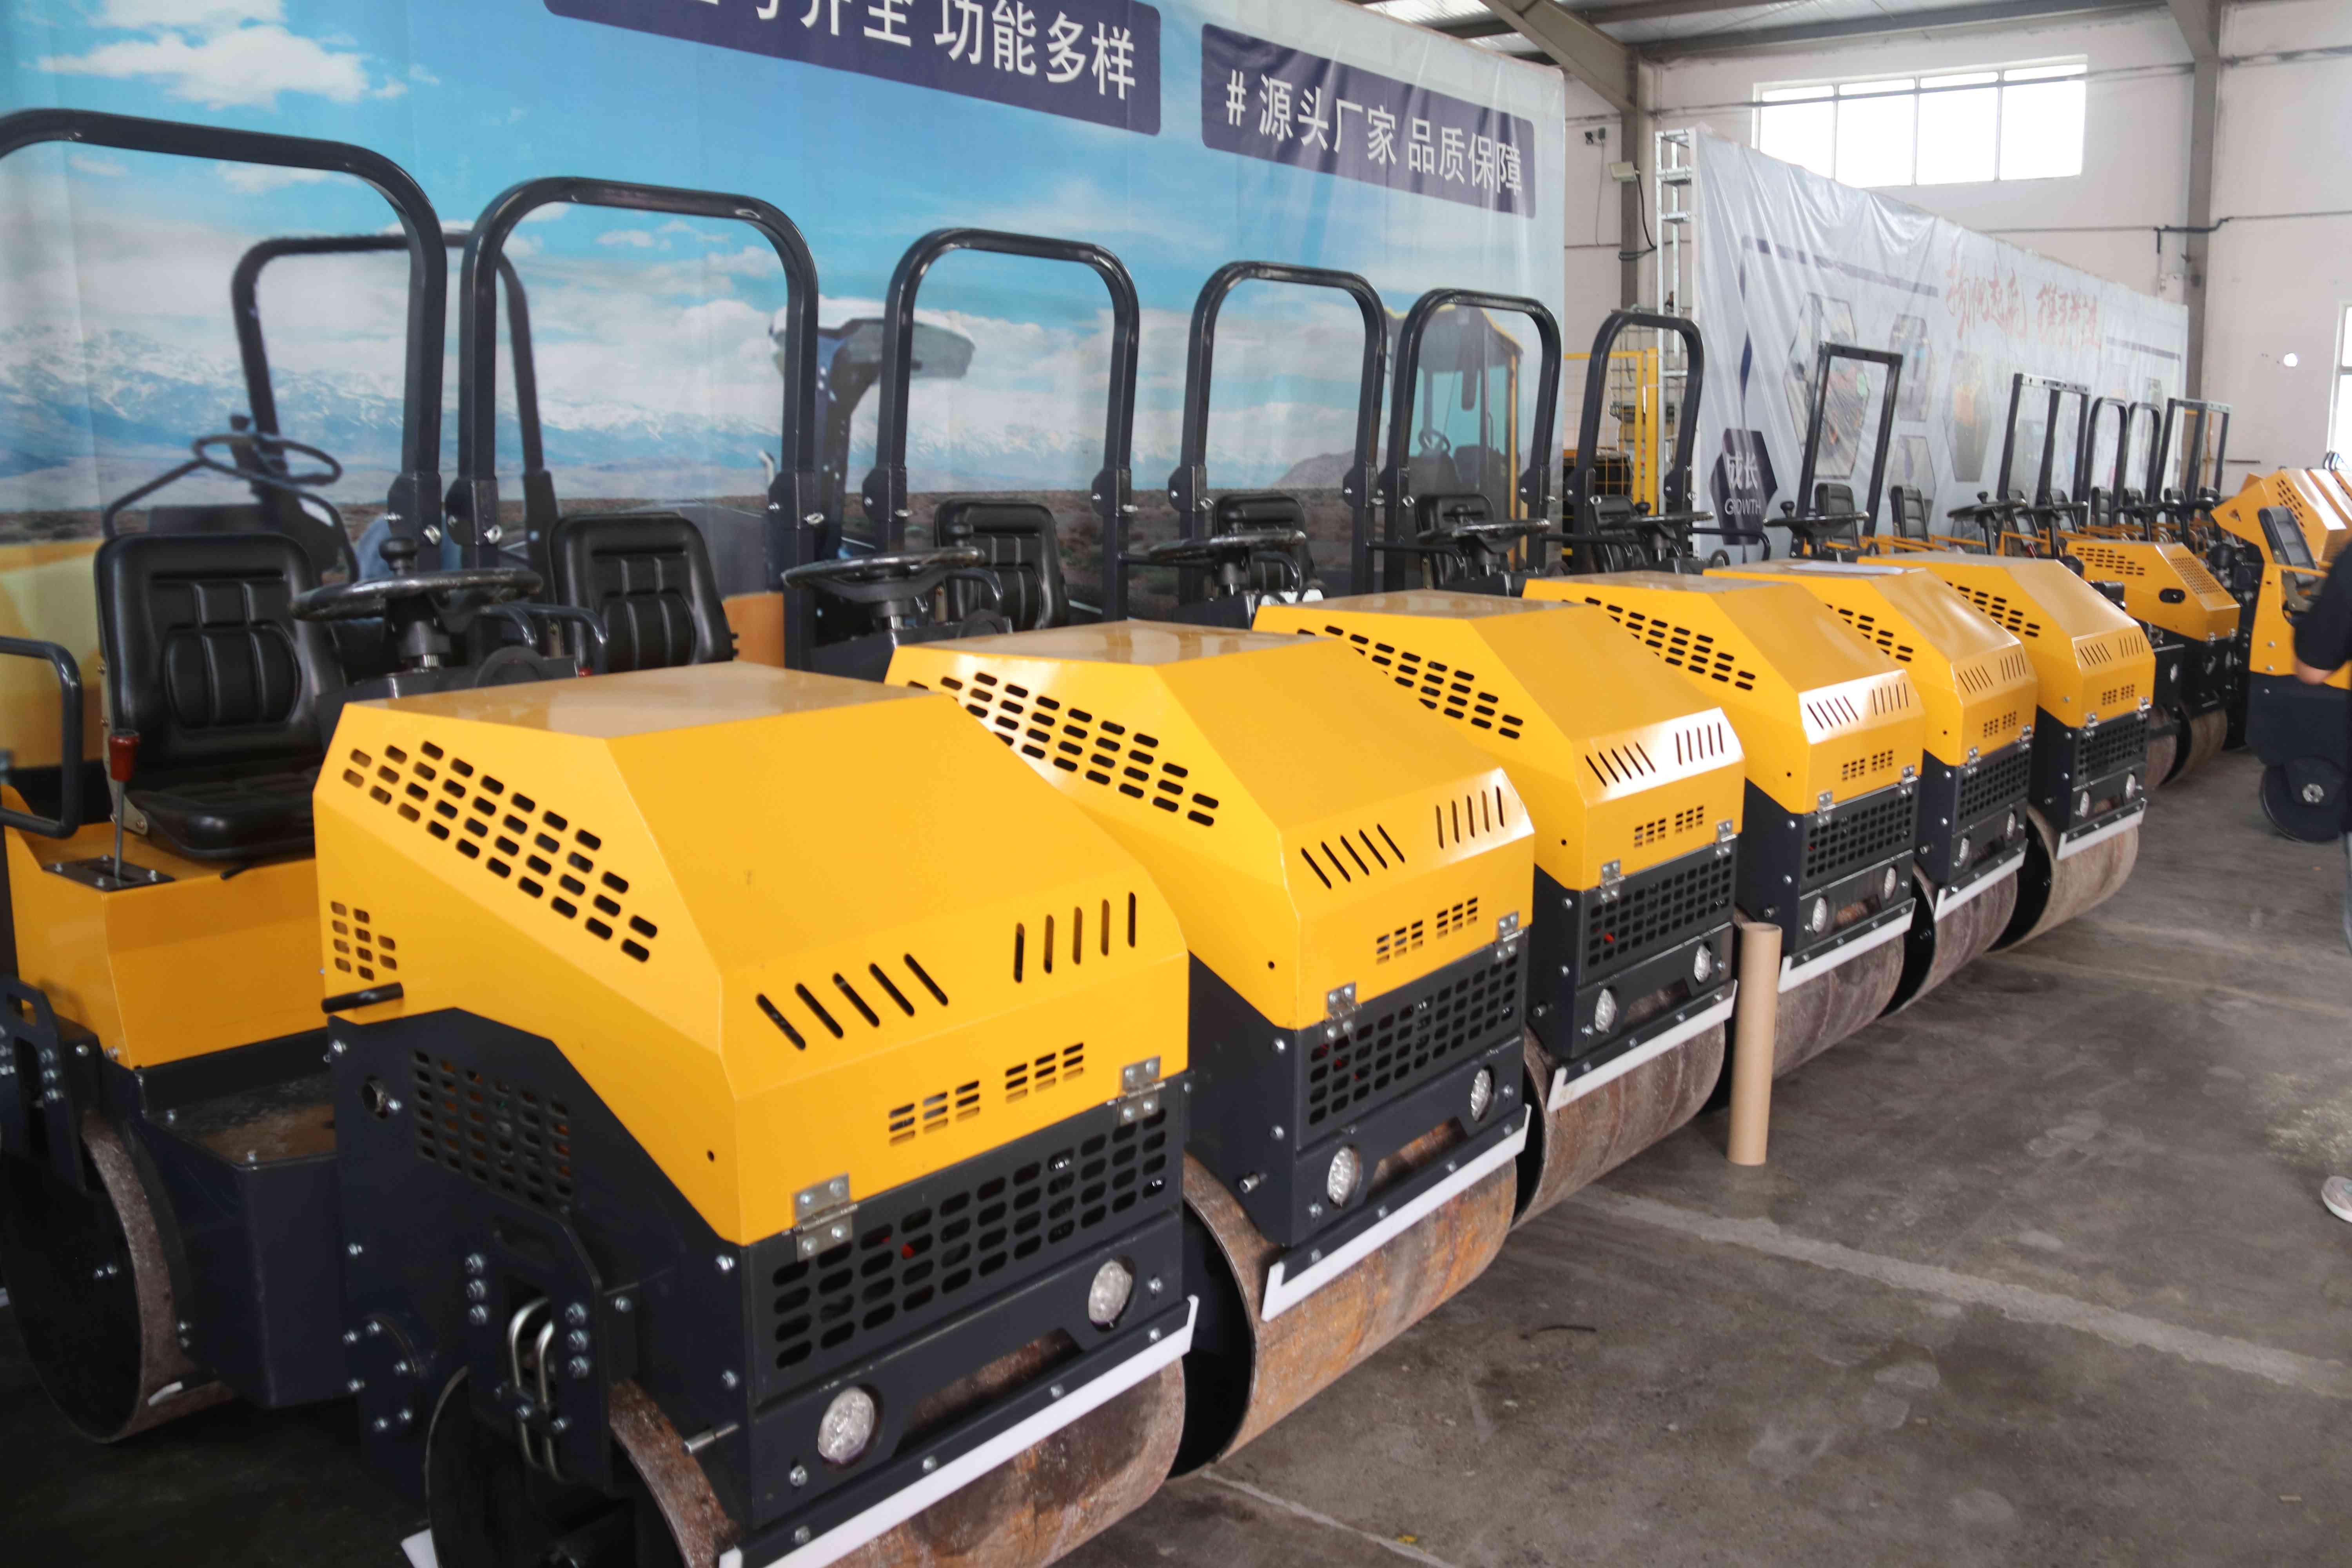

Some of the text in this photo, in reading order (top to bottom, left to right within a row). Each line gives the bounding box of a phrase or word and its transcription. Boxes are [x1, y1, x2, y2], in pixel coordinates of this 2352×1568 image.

[933, 0, 1136, 100] 功能多样
[1408, 116, 1522, 197] 品质保障
[1726, 450, 1759, 490] 成长
